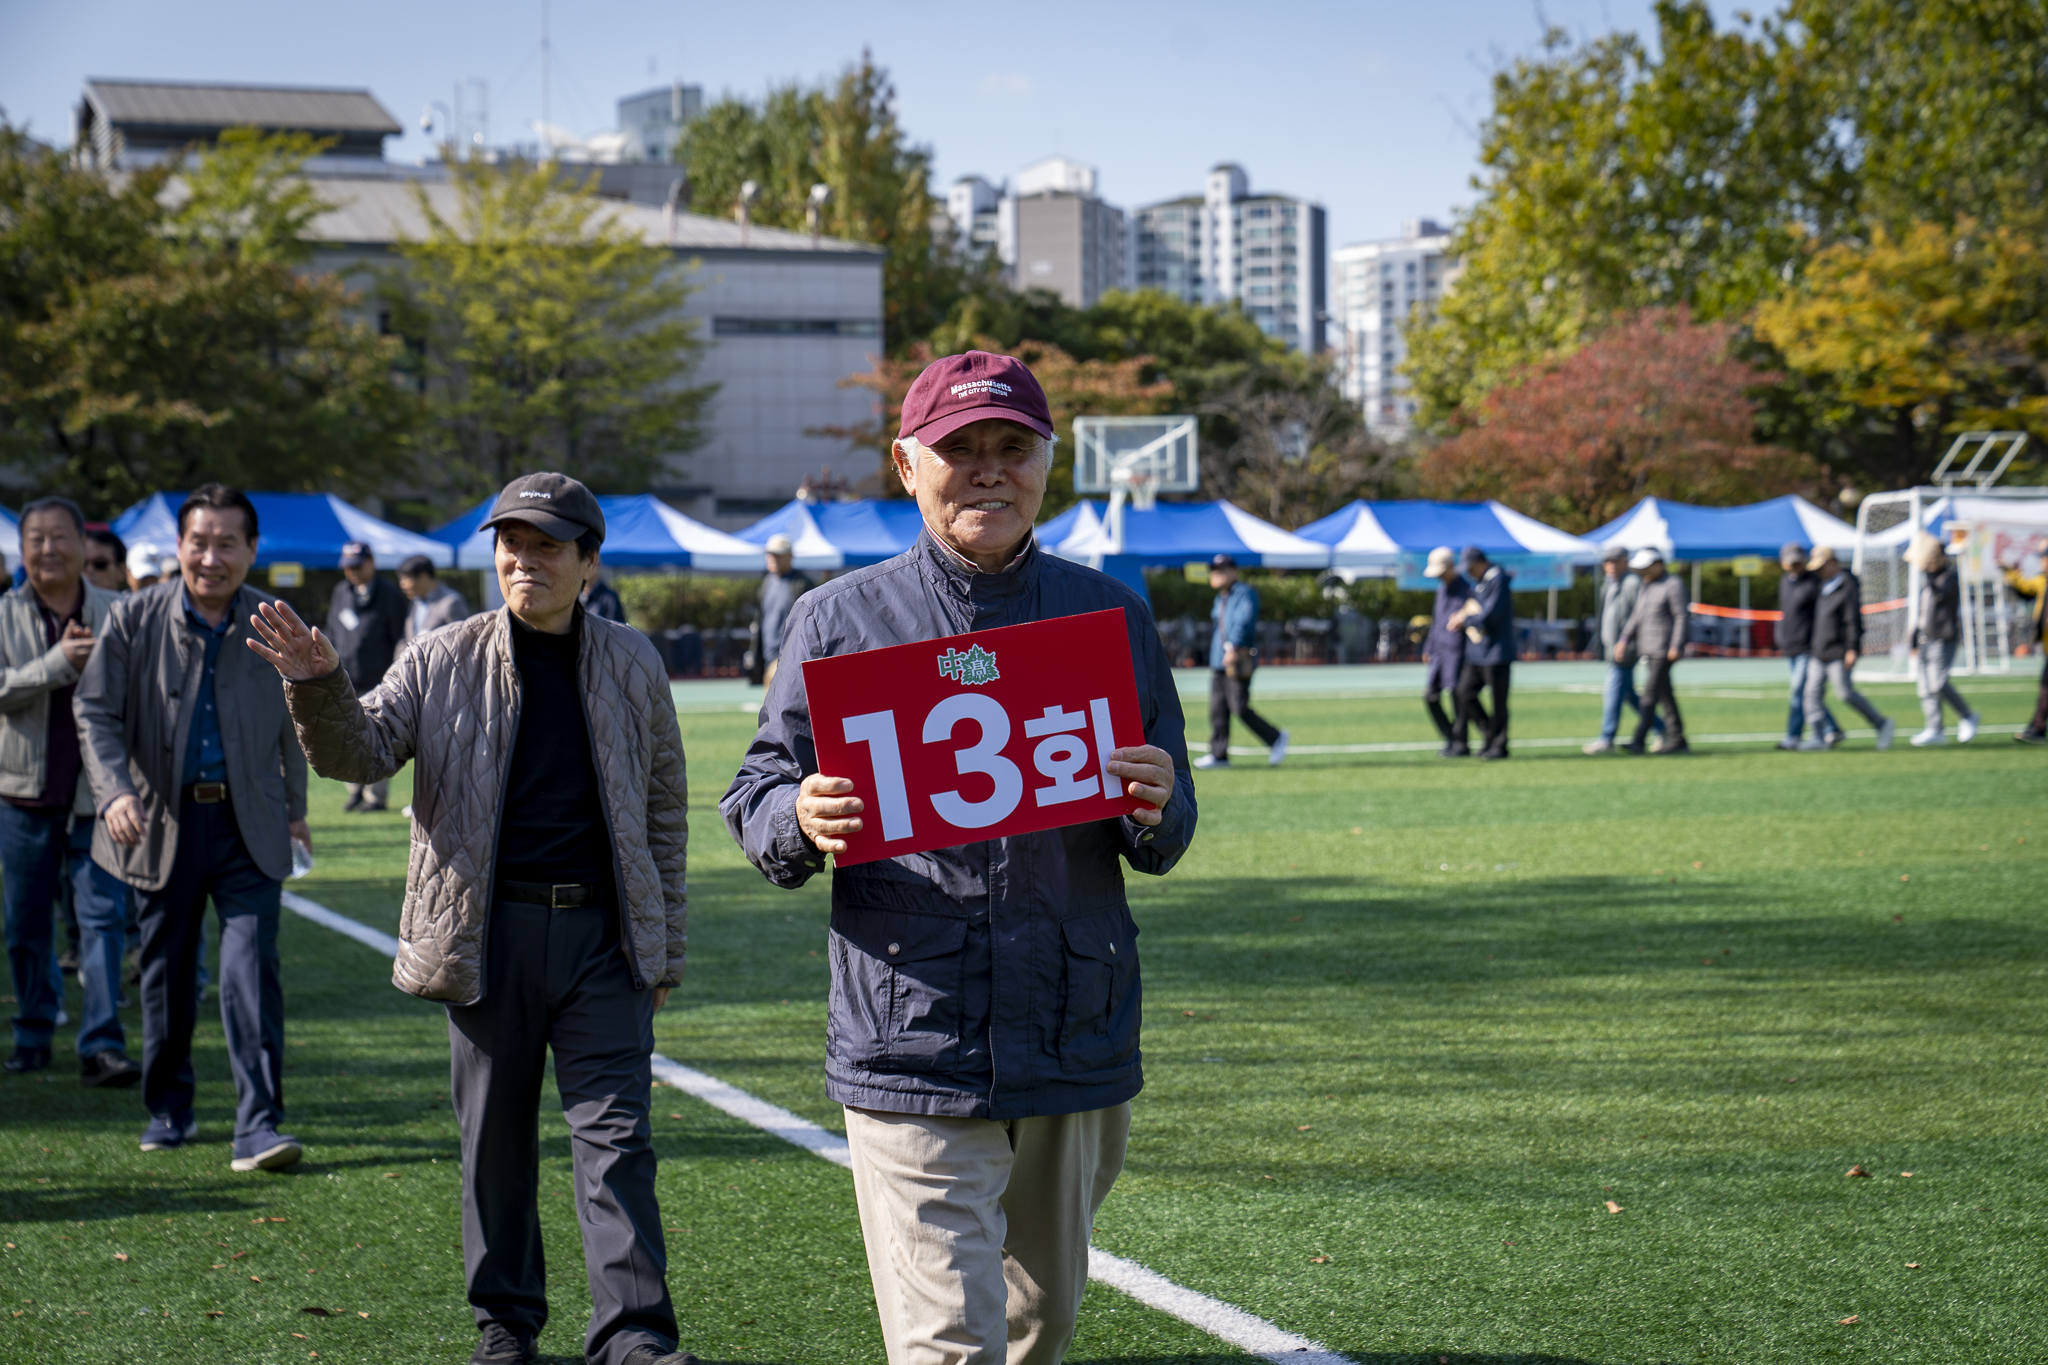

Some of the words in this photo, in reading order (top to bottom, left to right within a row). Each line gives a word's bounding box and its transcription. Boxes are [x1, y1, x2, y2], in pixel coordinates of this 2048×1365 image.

[951, 379, 1012, 395] Massachusetts
[957, 390, 968, 399] THE
[841, 692, 1124, 842] 13회
